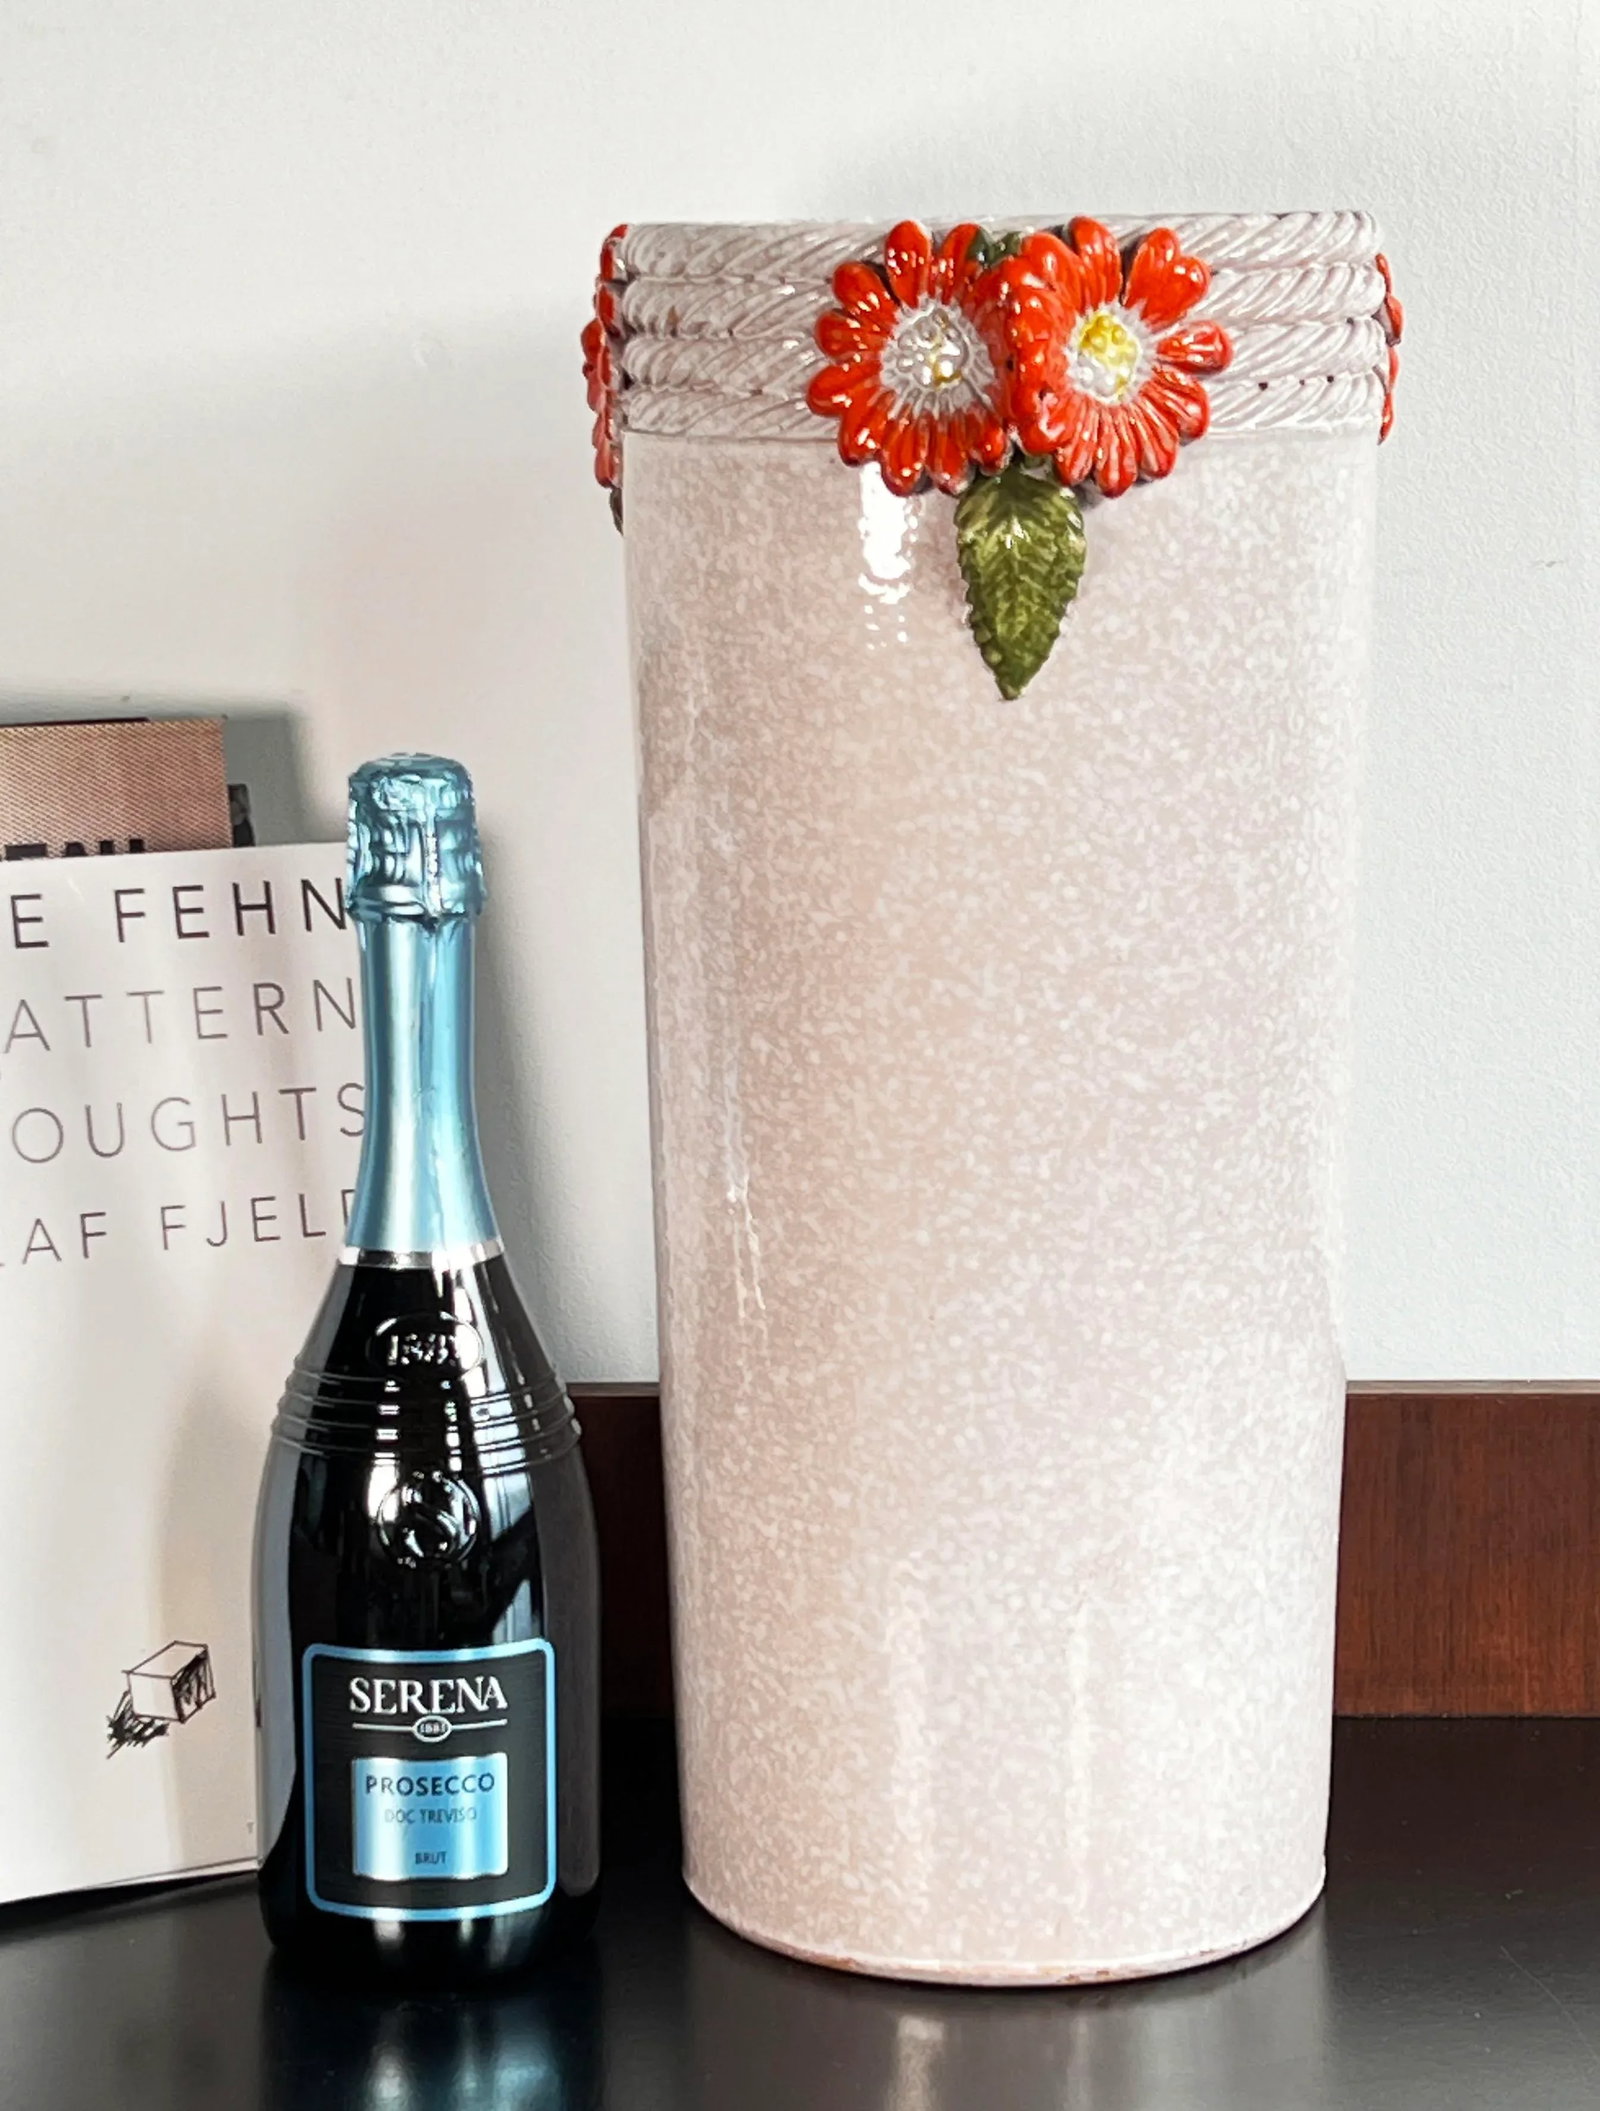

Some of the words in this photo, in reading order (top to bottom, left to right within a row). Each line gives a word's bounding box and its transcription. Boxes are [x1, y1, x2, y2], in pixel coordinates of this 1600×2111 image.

[114, 877, 348, 943] FEHN
[0, 1211, 108, 1266] AF
[349, 1675, 509, 1715] SERENA
[365, 1772, 496, 1797] PROSECCO
[384, 1808, 416, 1824] DOC
[420, 1807, 478, 1825] TREVISO
[415, 1850, 448, 1866] BRUT
